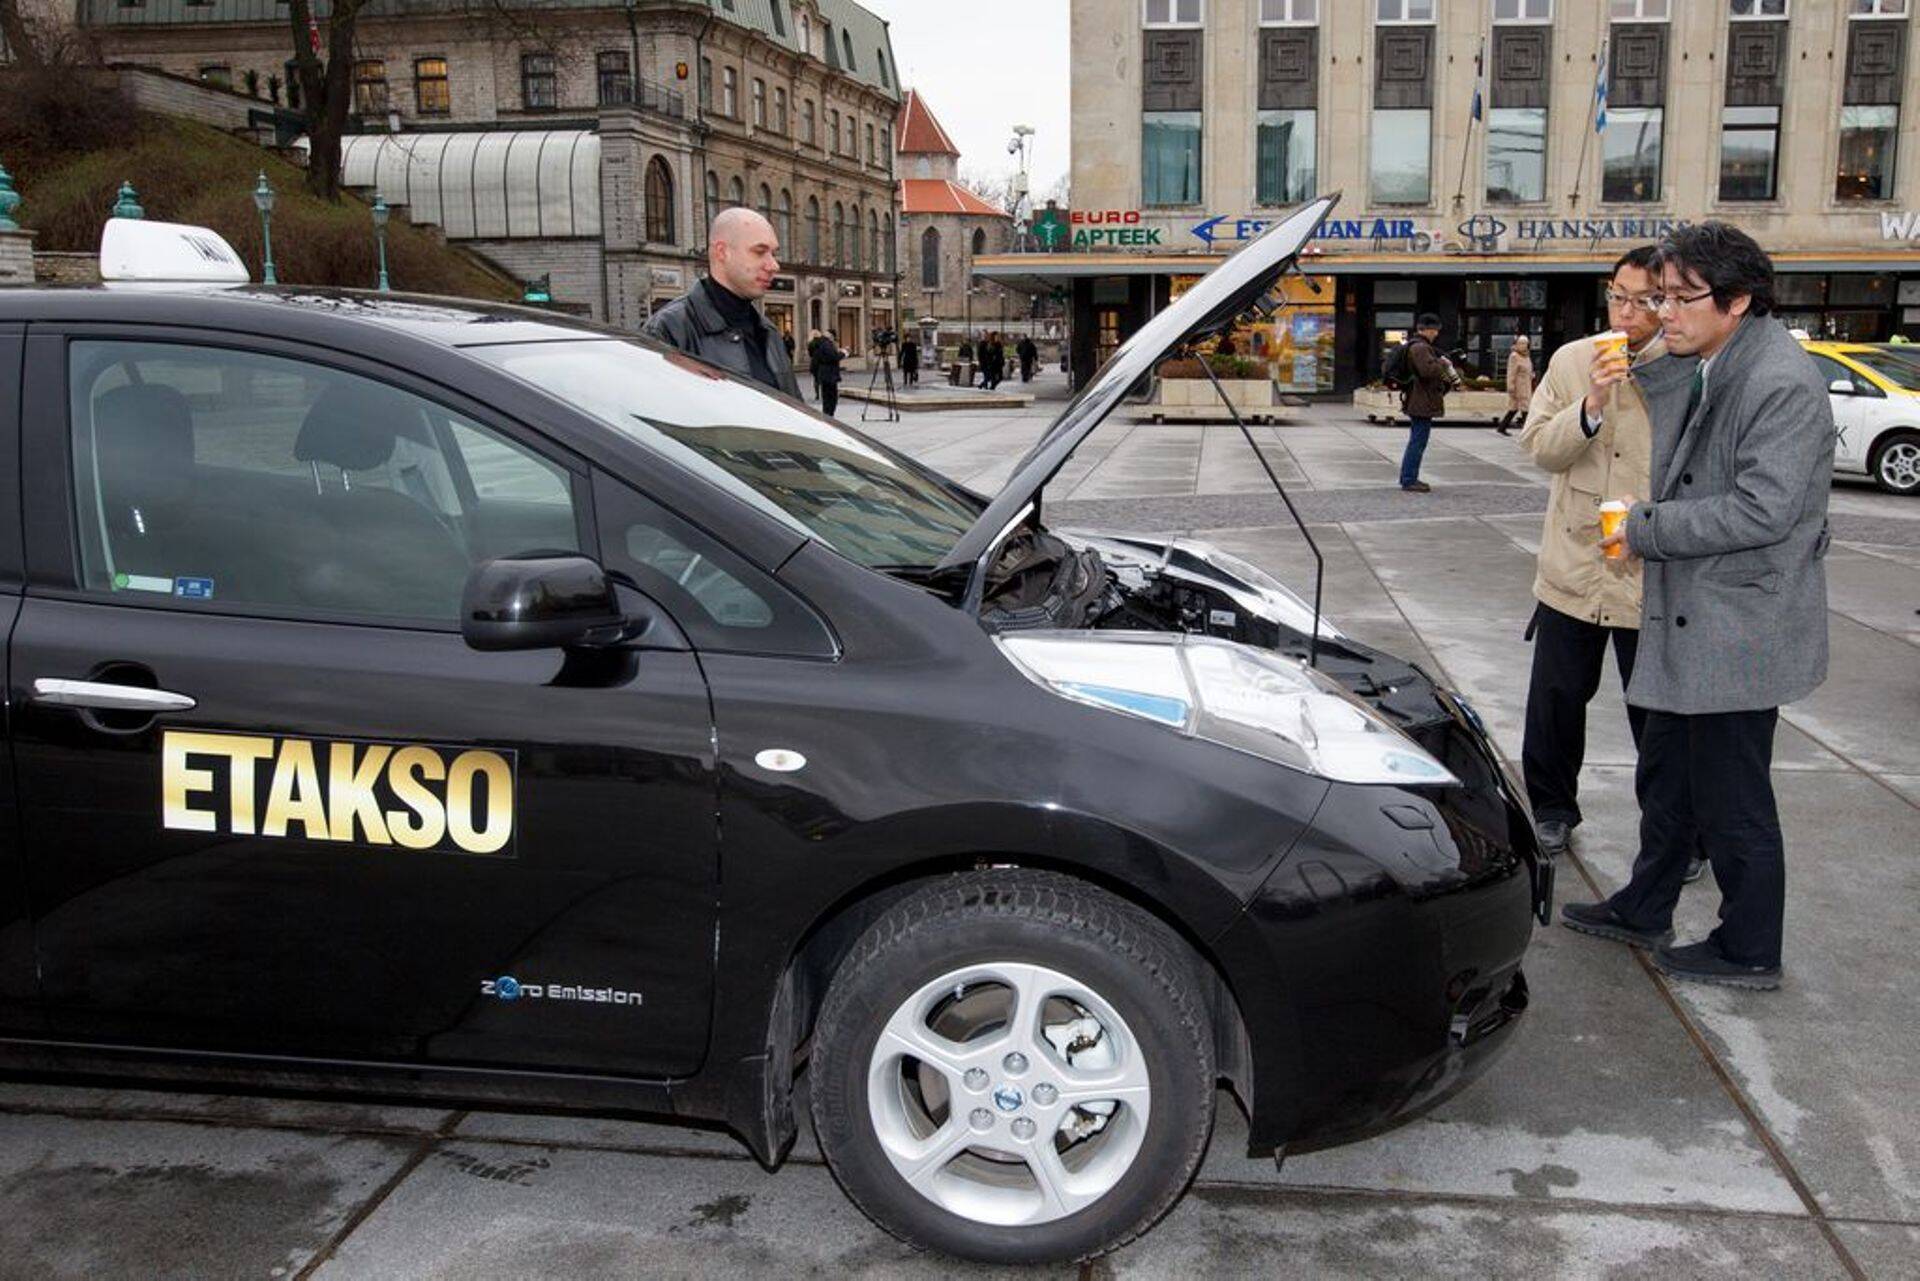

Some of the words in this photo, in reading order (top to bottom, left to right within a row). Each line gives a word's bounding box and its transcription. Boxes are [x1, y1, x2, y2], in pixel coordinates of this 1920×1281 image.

[1071, 211, 1140, 224] EURO
[1236, 219, 1362, 239] ESIAN
[1370, 217, 1415, 239] AIR
[1074, 228, 1161, 245] APTEEK
[163, 730, 513, 854] ETAKSO
[547, 984, 642, 1006] Emission
